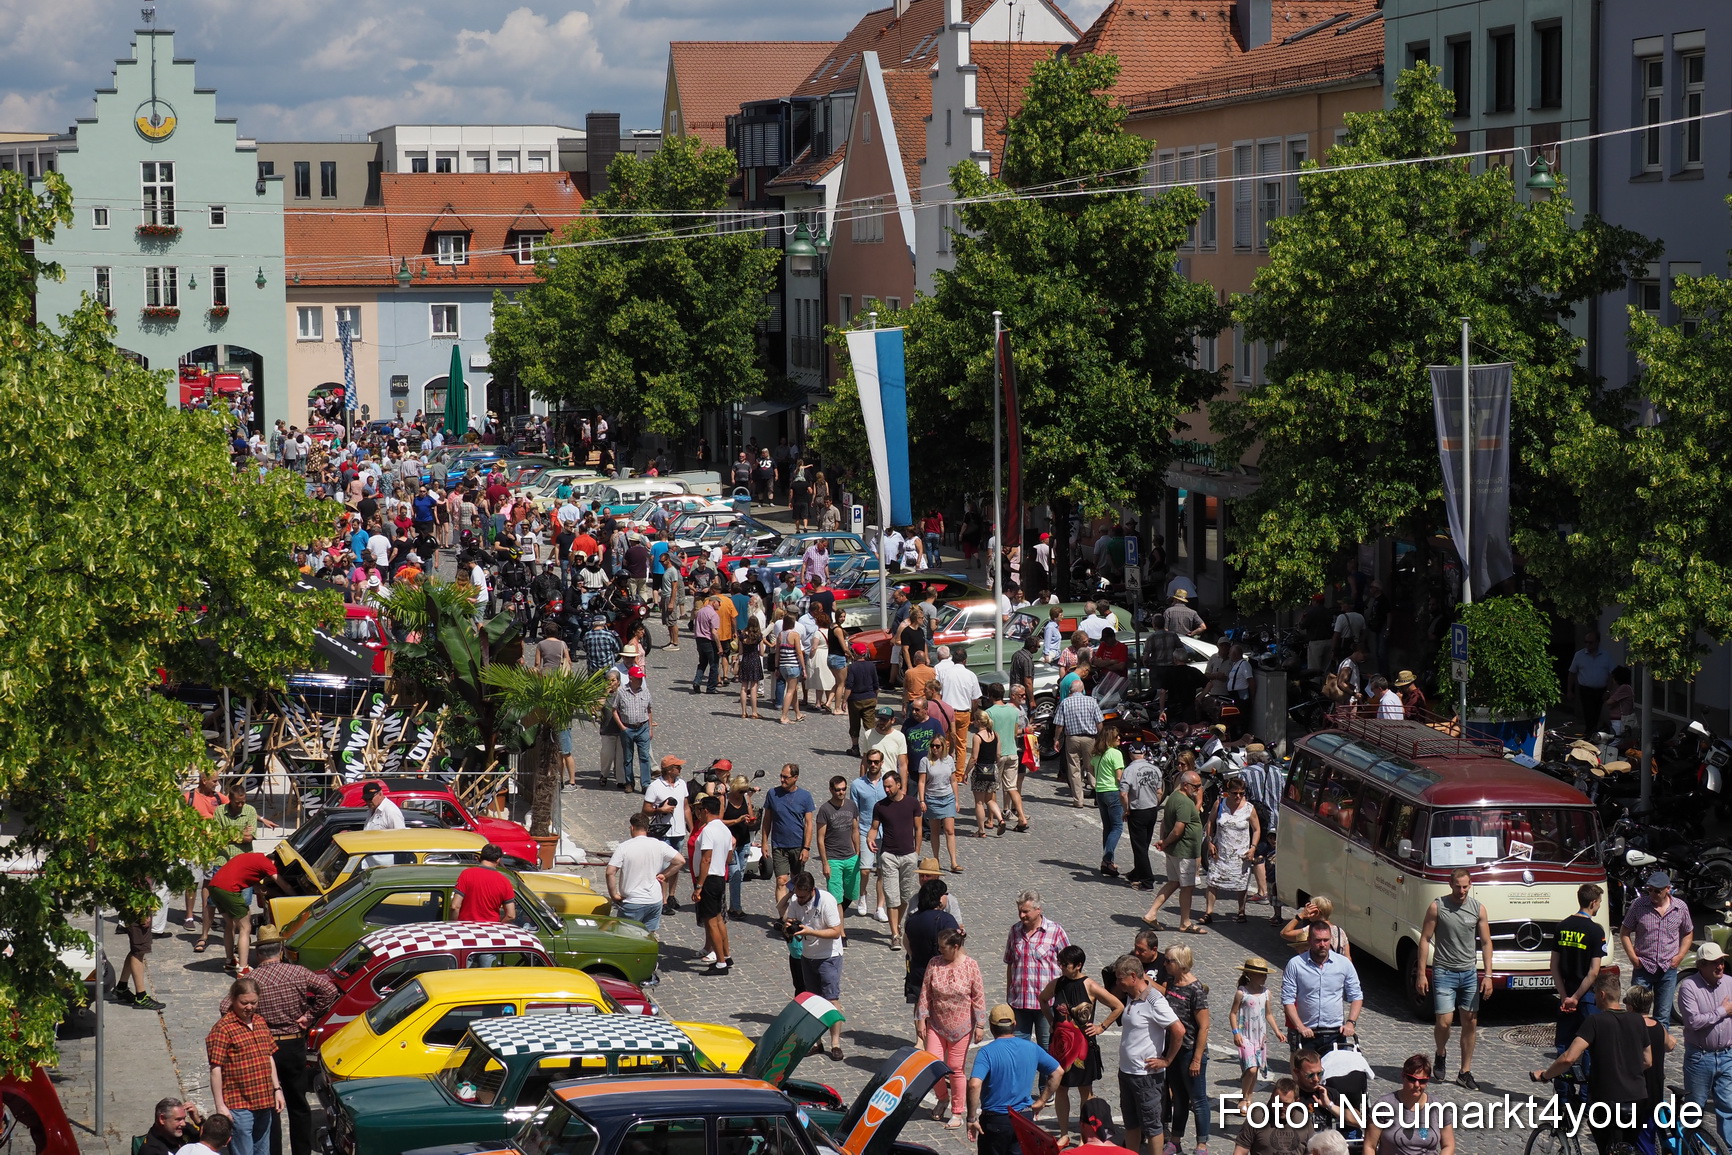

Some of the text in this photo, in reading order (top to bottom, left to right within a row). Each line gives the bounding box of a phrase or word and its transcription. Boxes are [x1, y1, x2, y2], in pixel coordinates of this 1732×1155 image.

[855, 509, 860, 517] P
[1127, 540, 1135, 560] P
[1455, 628, 1463, 654] P
[1560, 930, 1585, 942] THW
[871, 1090, 897, 1111] Gulf
